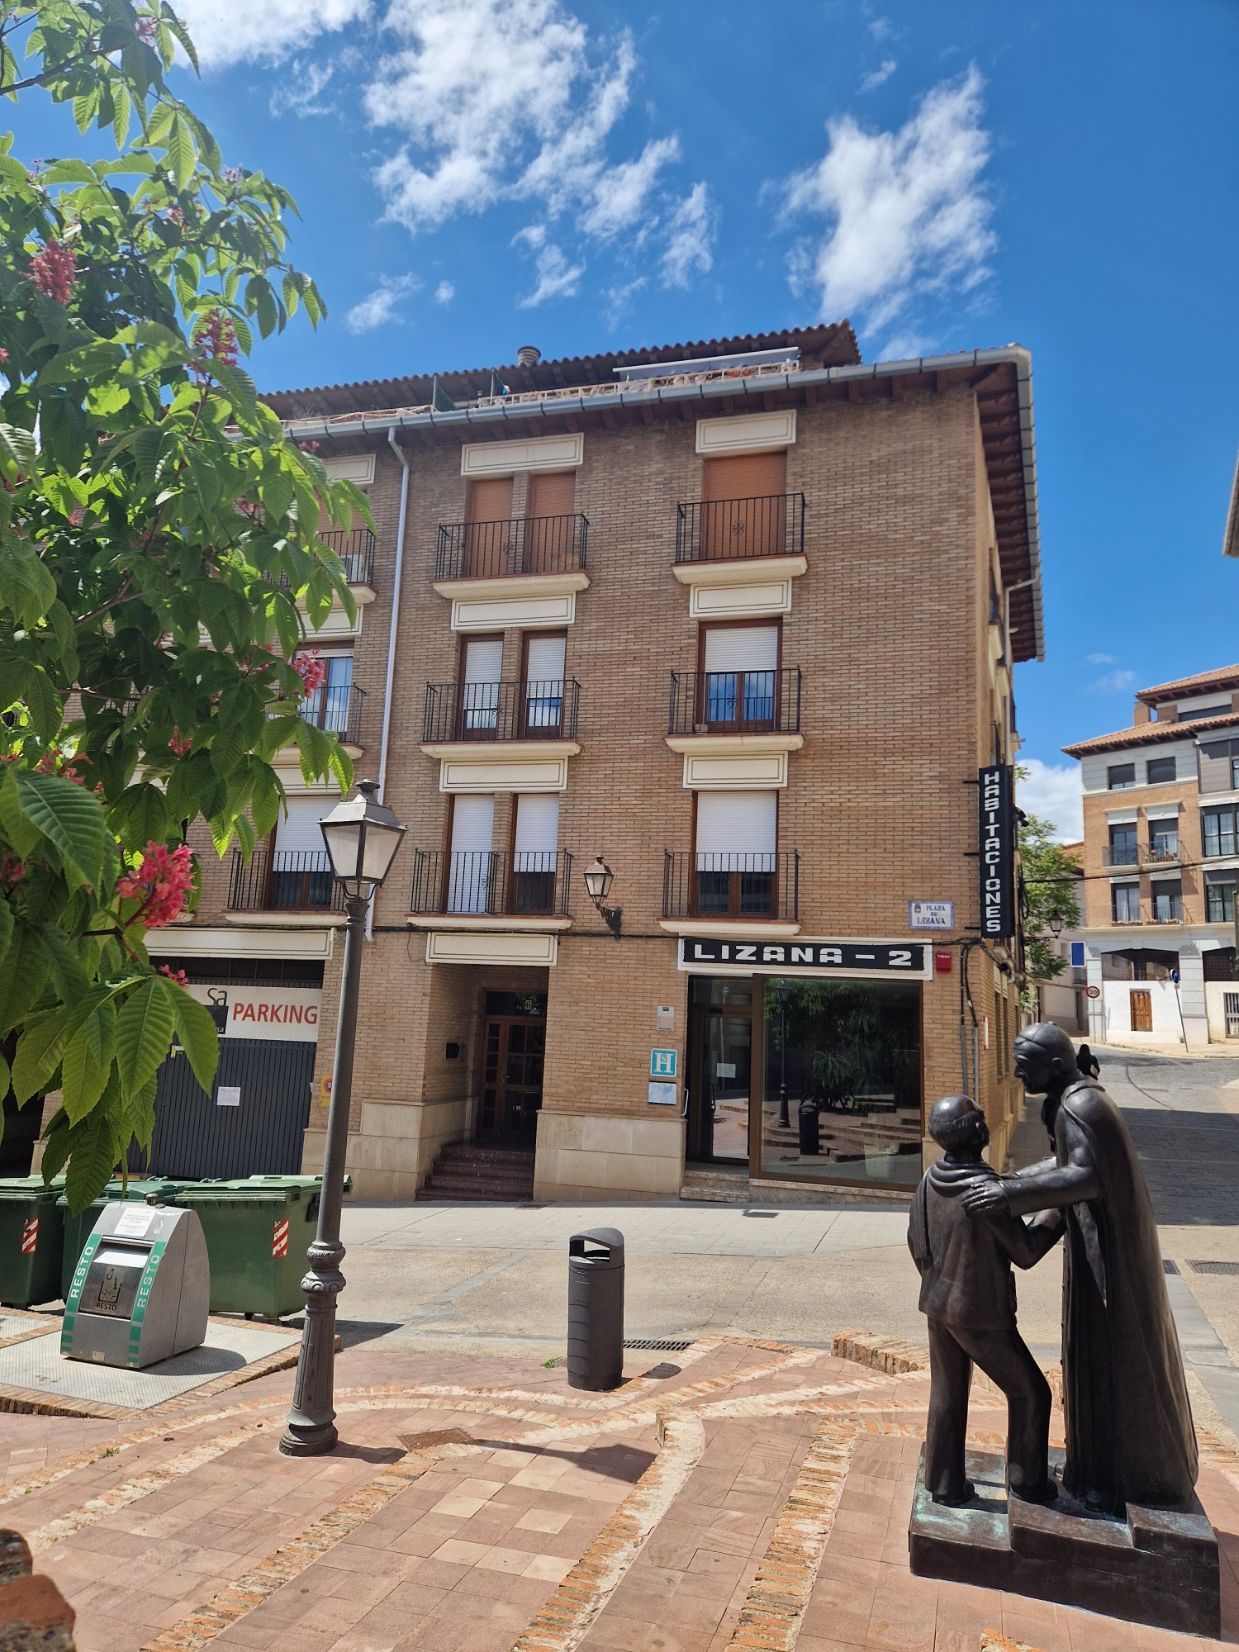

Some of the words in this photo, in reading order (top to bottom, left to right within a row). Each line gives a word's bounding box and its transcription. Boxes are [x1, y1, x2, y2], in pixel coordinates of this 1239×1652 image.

[984, 771, 1001, 933] HABITACIONES
[917, 917, 946, 925] LIZANA
[694, 944, 843, 964] LIZANA
[888, 950, 912, 966] 2
[232, 1002, 318, 1025] PARKING
[70, 1246, 94, 1299] RESTO
[136, 1254, 161, 1308] RESTO
